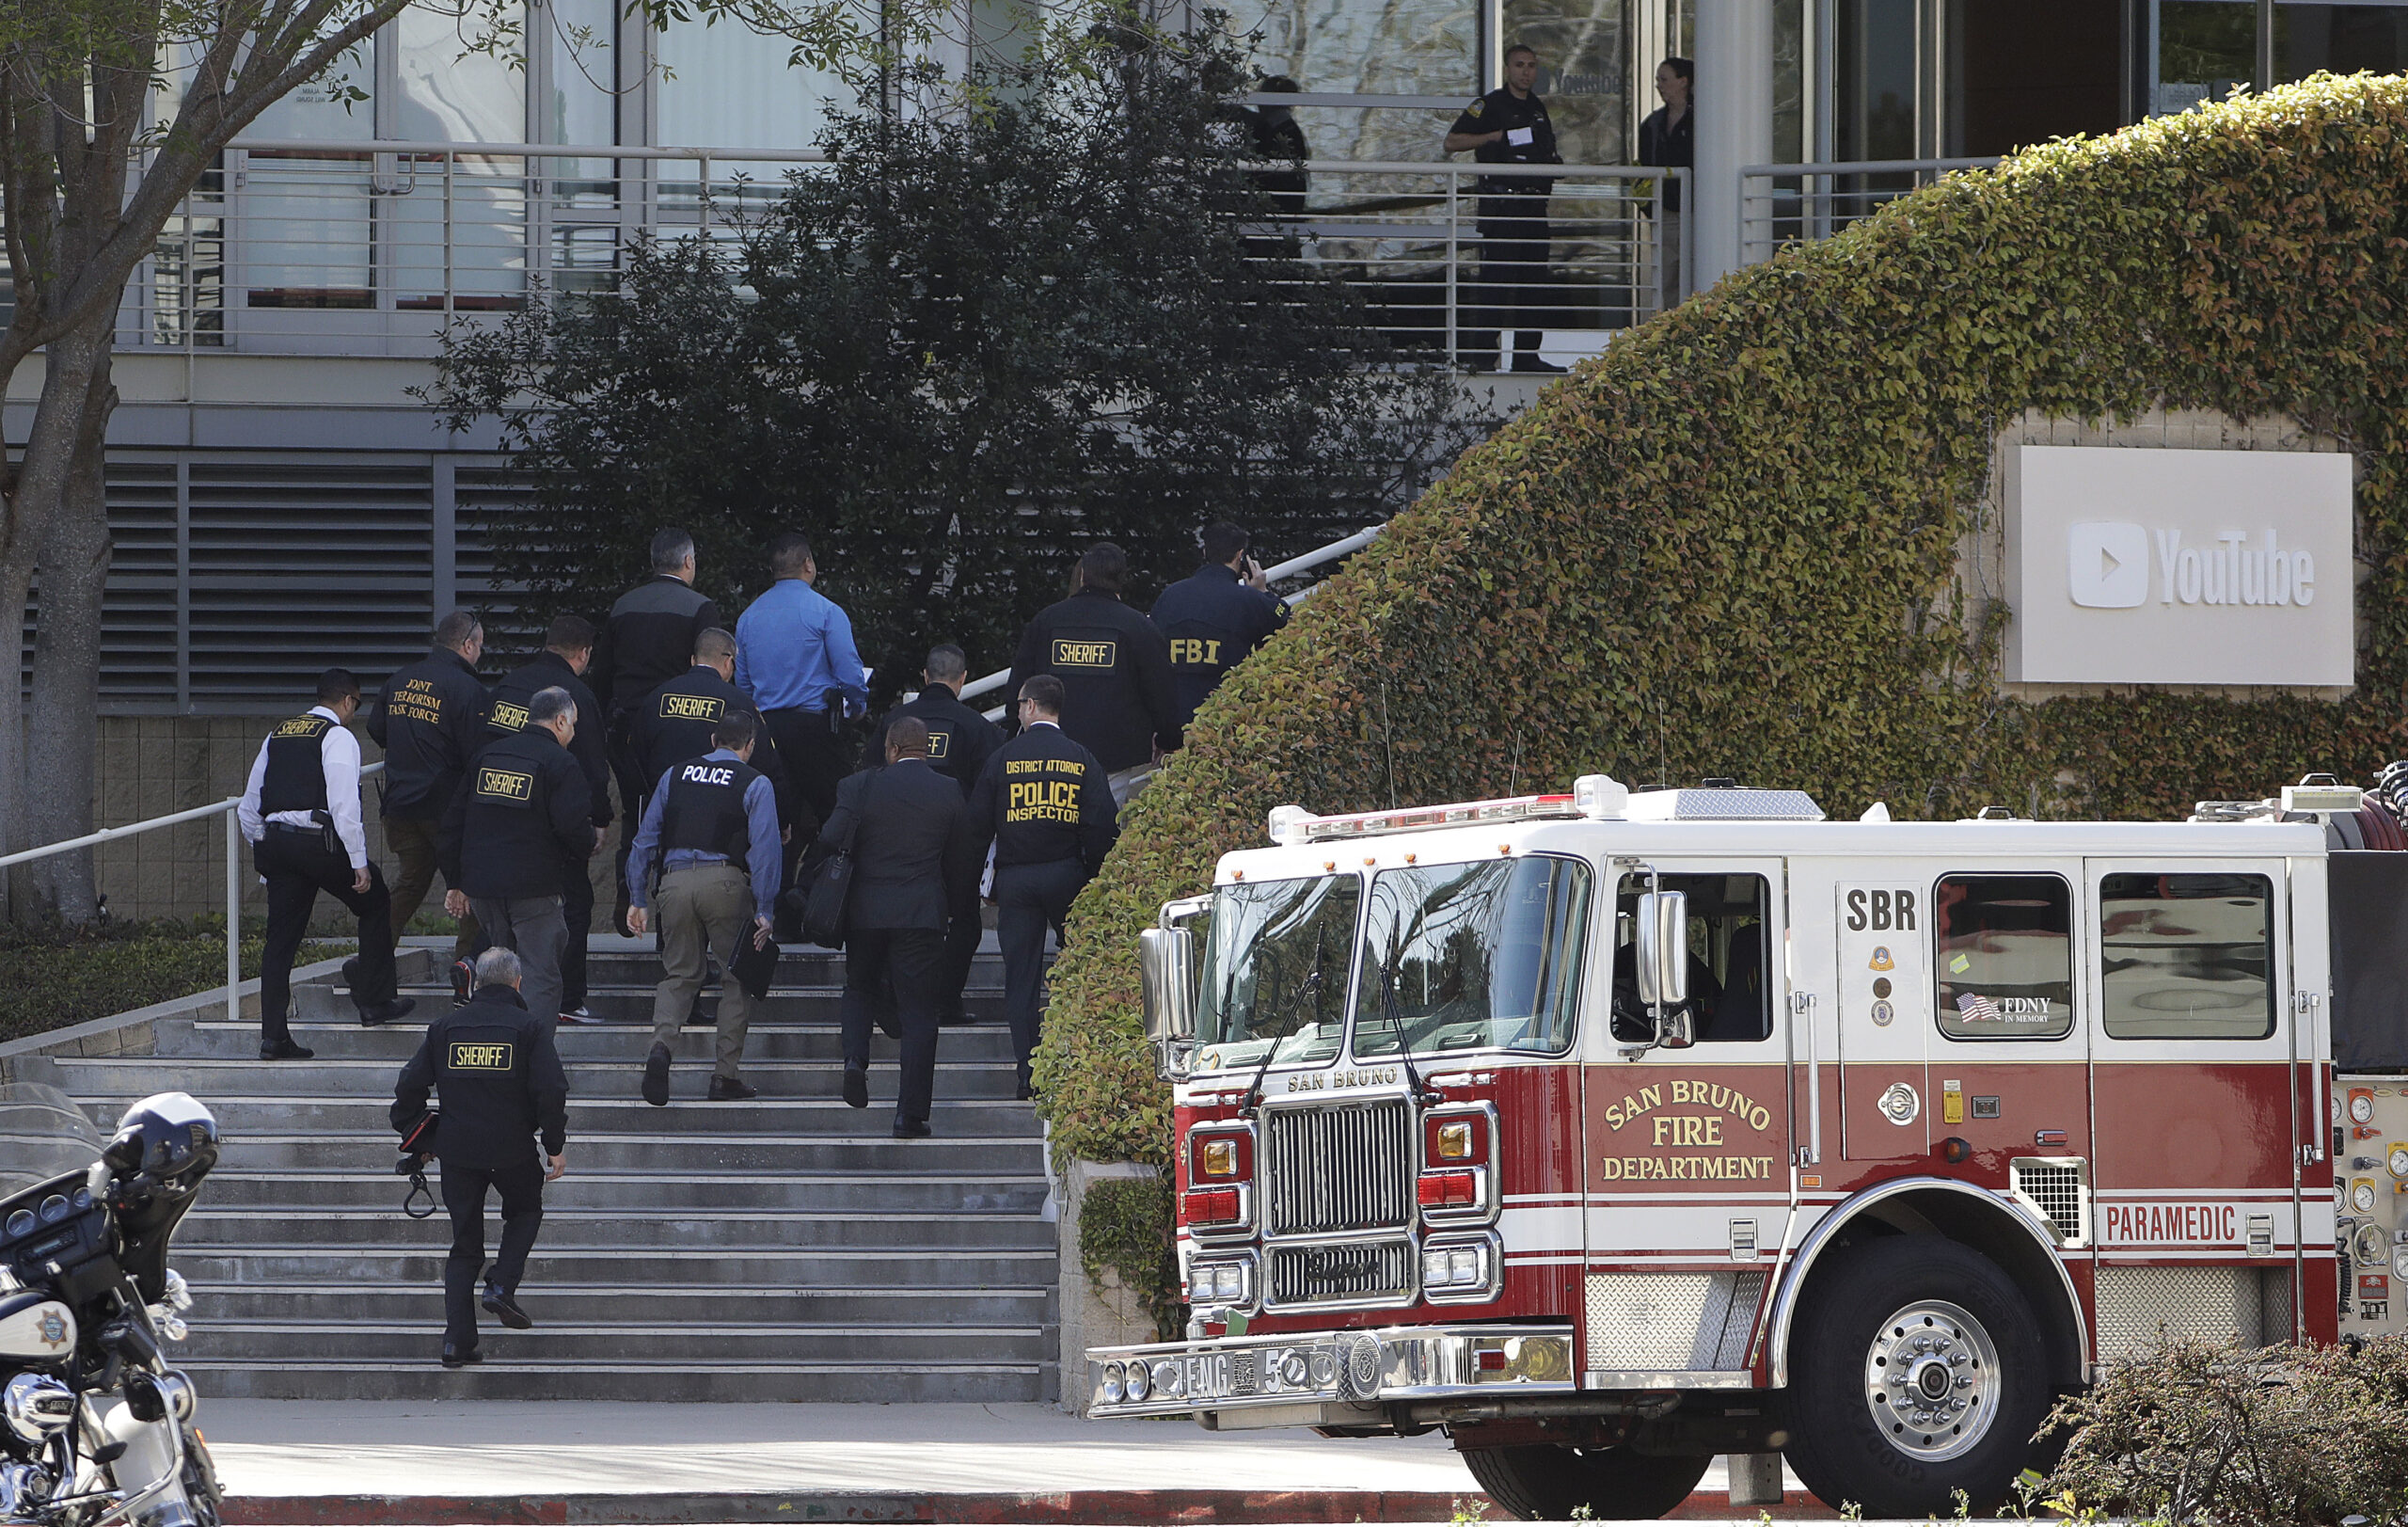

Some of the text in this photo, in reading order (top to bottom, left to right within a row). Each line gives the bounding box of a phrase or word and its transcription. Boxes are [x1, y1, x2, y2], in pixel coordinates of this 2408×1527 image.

[2154, 528, 2315, 607] YouTube
[1059, 644, 1108, 663] SHERIFF
[1170, 638, 1221, 665] FBI
[405, 678, 433, 692] JOINT
[393, 691, 441, 710] TERRORISM
[667, 696, 717, 718] SHERIFF
[388, 704, 439, 724] TASK FORCE
[491, 704, 529, 729] SHERIFF
[277, 720, 320, 735] SHERIFF
[682, 765, 734, 786] POLICE
[1006, 759, 1043, 774] DISTRICT
[483, 772, 525, 796] SHERIFF
[1010, 781, 1081, 809] POLICE
[1006, 805, 1080, 824] INSPECTOR
[1846, 889, 1916, 931] SBR
[2004, 997, 2052, 1013] FDNY
[2018, 1015, 2049, 1024] MEMORY
[456, 1046, 504, 1066] SHERIFF
[1288, 1066, 1398, 1092] SAN BRUNO
[1605, 1080, 1770, 1131] SAN BRUNO
[1653, 1116, 1723, 1146] FIRE
[1603, 1156, 1774, 1180] DEPARTMENT
[2107, 1205, 2235, 1241] PARAMEDIC
